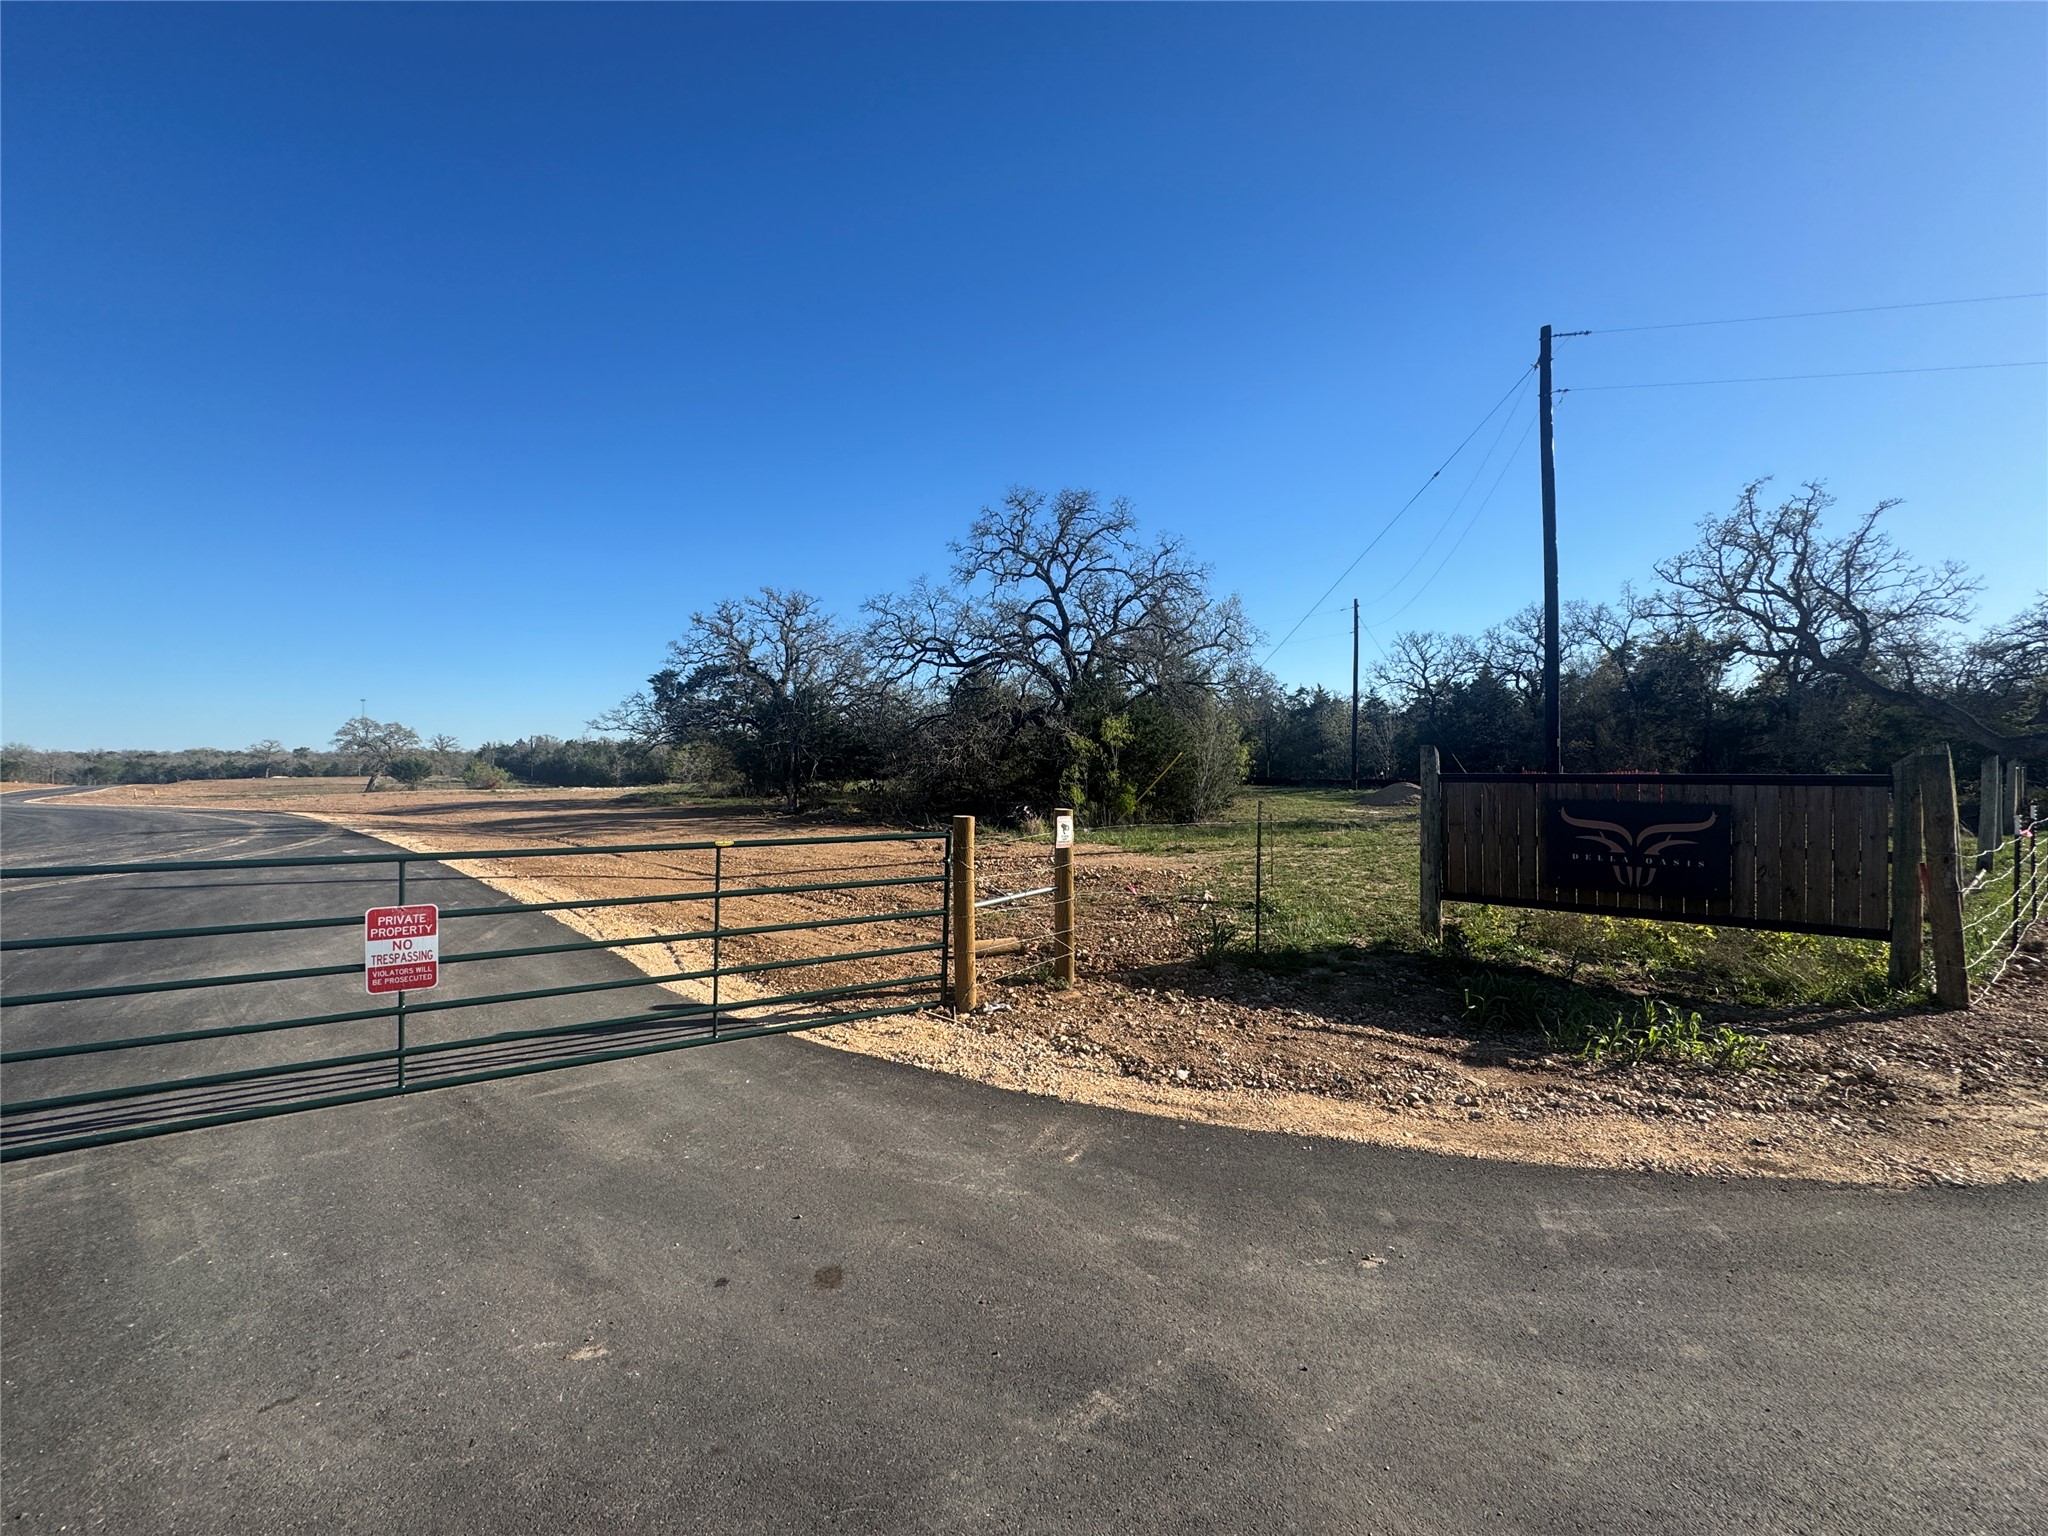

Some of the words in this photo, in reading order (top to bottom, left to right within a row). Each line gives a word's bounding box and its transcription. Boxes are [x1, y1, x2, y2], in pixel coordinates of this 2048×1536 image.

[1572, 853, 1629, 863] DELLA
[1645, 857, 1705, 868] OASIS
[378, 914, 427, 926] PRIVATE
[370, 924, 433, 938] PROPERTY
[392, 939, 413, 951] NO
[371, 950, 433, 966] TRESPASSING
[372, 968, 414, 978] VIOLATORS
[372, 978, 382, 986] BE
[384, 974, 432, 985] PROSECUTED
